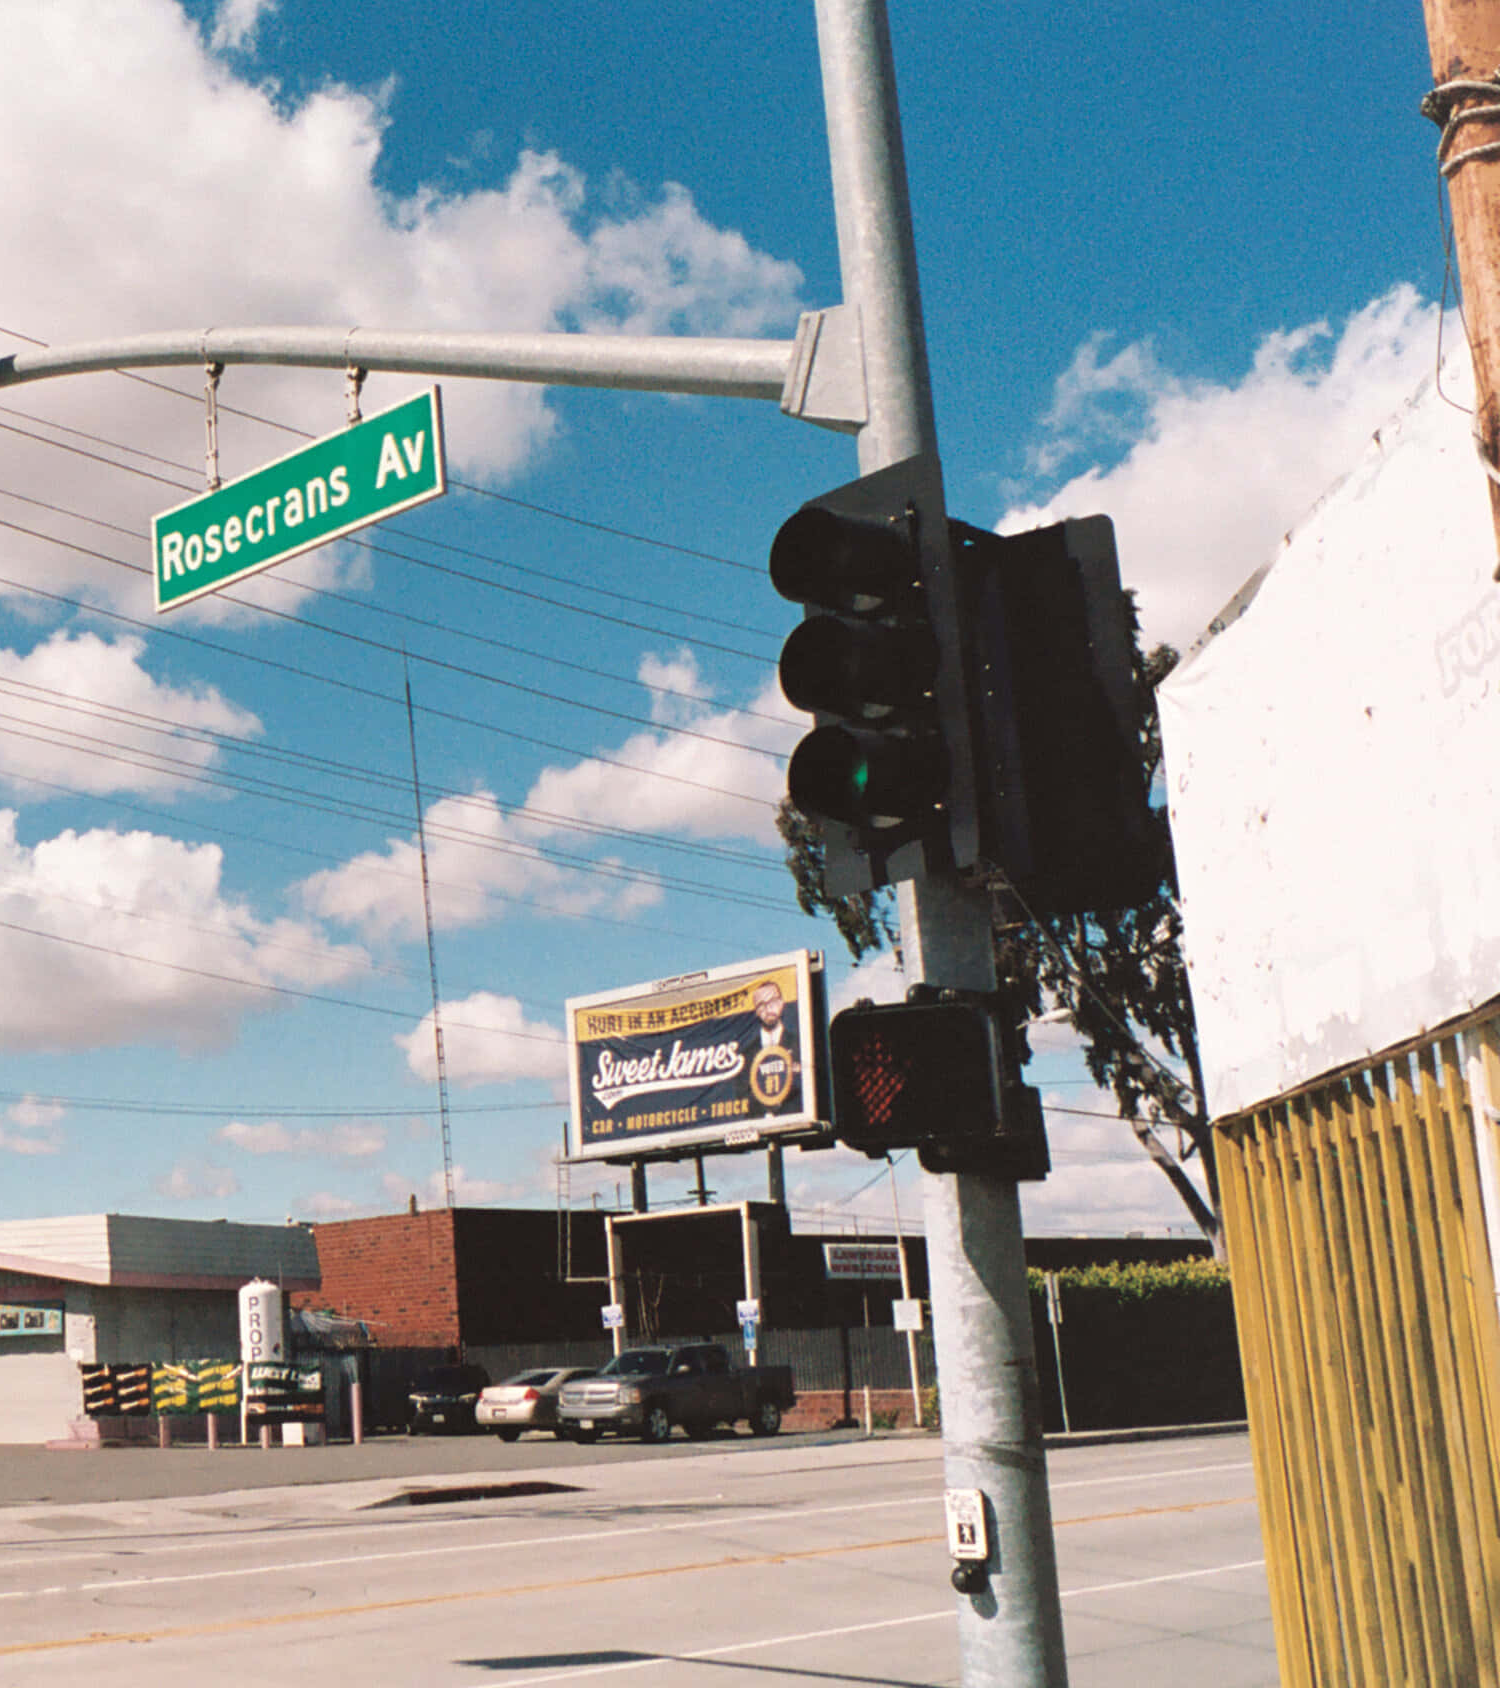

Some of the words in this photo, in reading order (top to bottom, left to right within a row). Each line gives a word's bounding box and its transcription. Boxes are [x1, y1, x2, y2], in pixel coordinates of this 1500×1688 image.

[161, 465, 351, 582] Rosecrans
[375, 430, 425, 490] Av
[586, 1014, 623, 1035] HURT
[627, 1012, 643, 1031] IN
[647, 1009, 666, 1028] AN
[670, 989, 749, 1023] ACCIDENT?
[592, 1047, 662, 1089] Sweet
[658, 1040, 744, 1078] James
[592, 1118, 613, 1135] CAR
[626, 1105, 698, 1130] MOTORCYCLE
[710, 1098, 749, 1118] TRUCK
[248, 1296, 263, 1361] PROP
